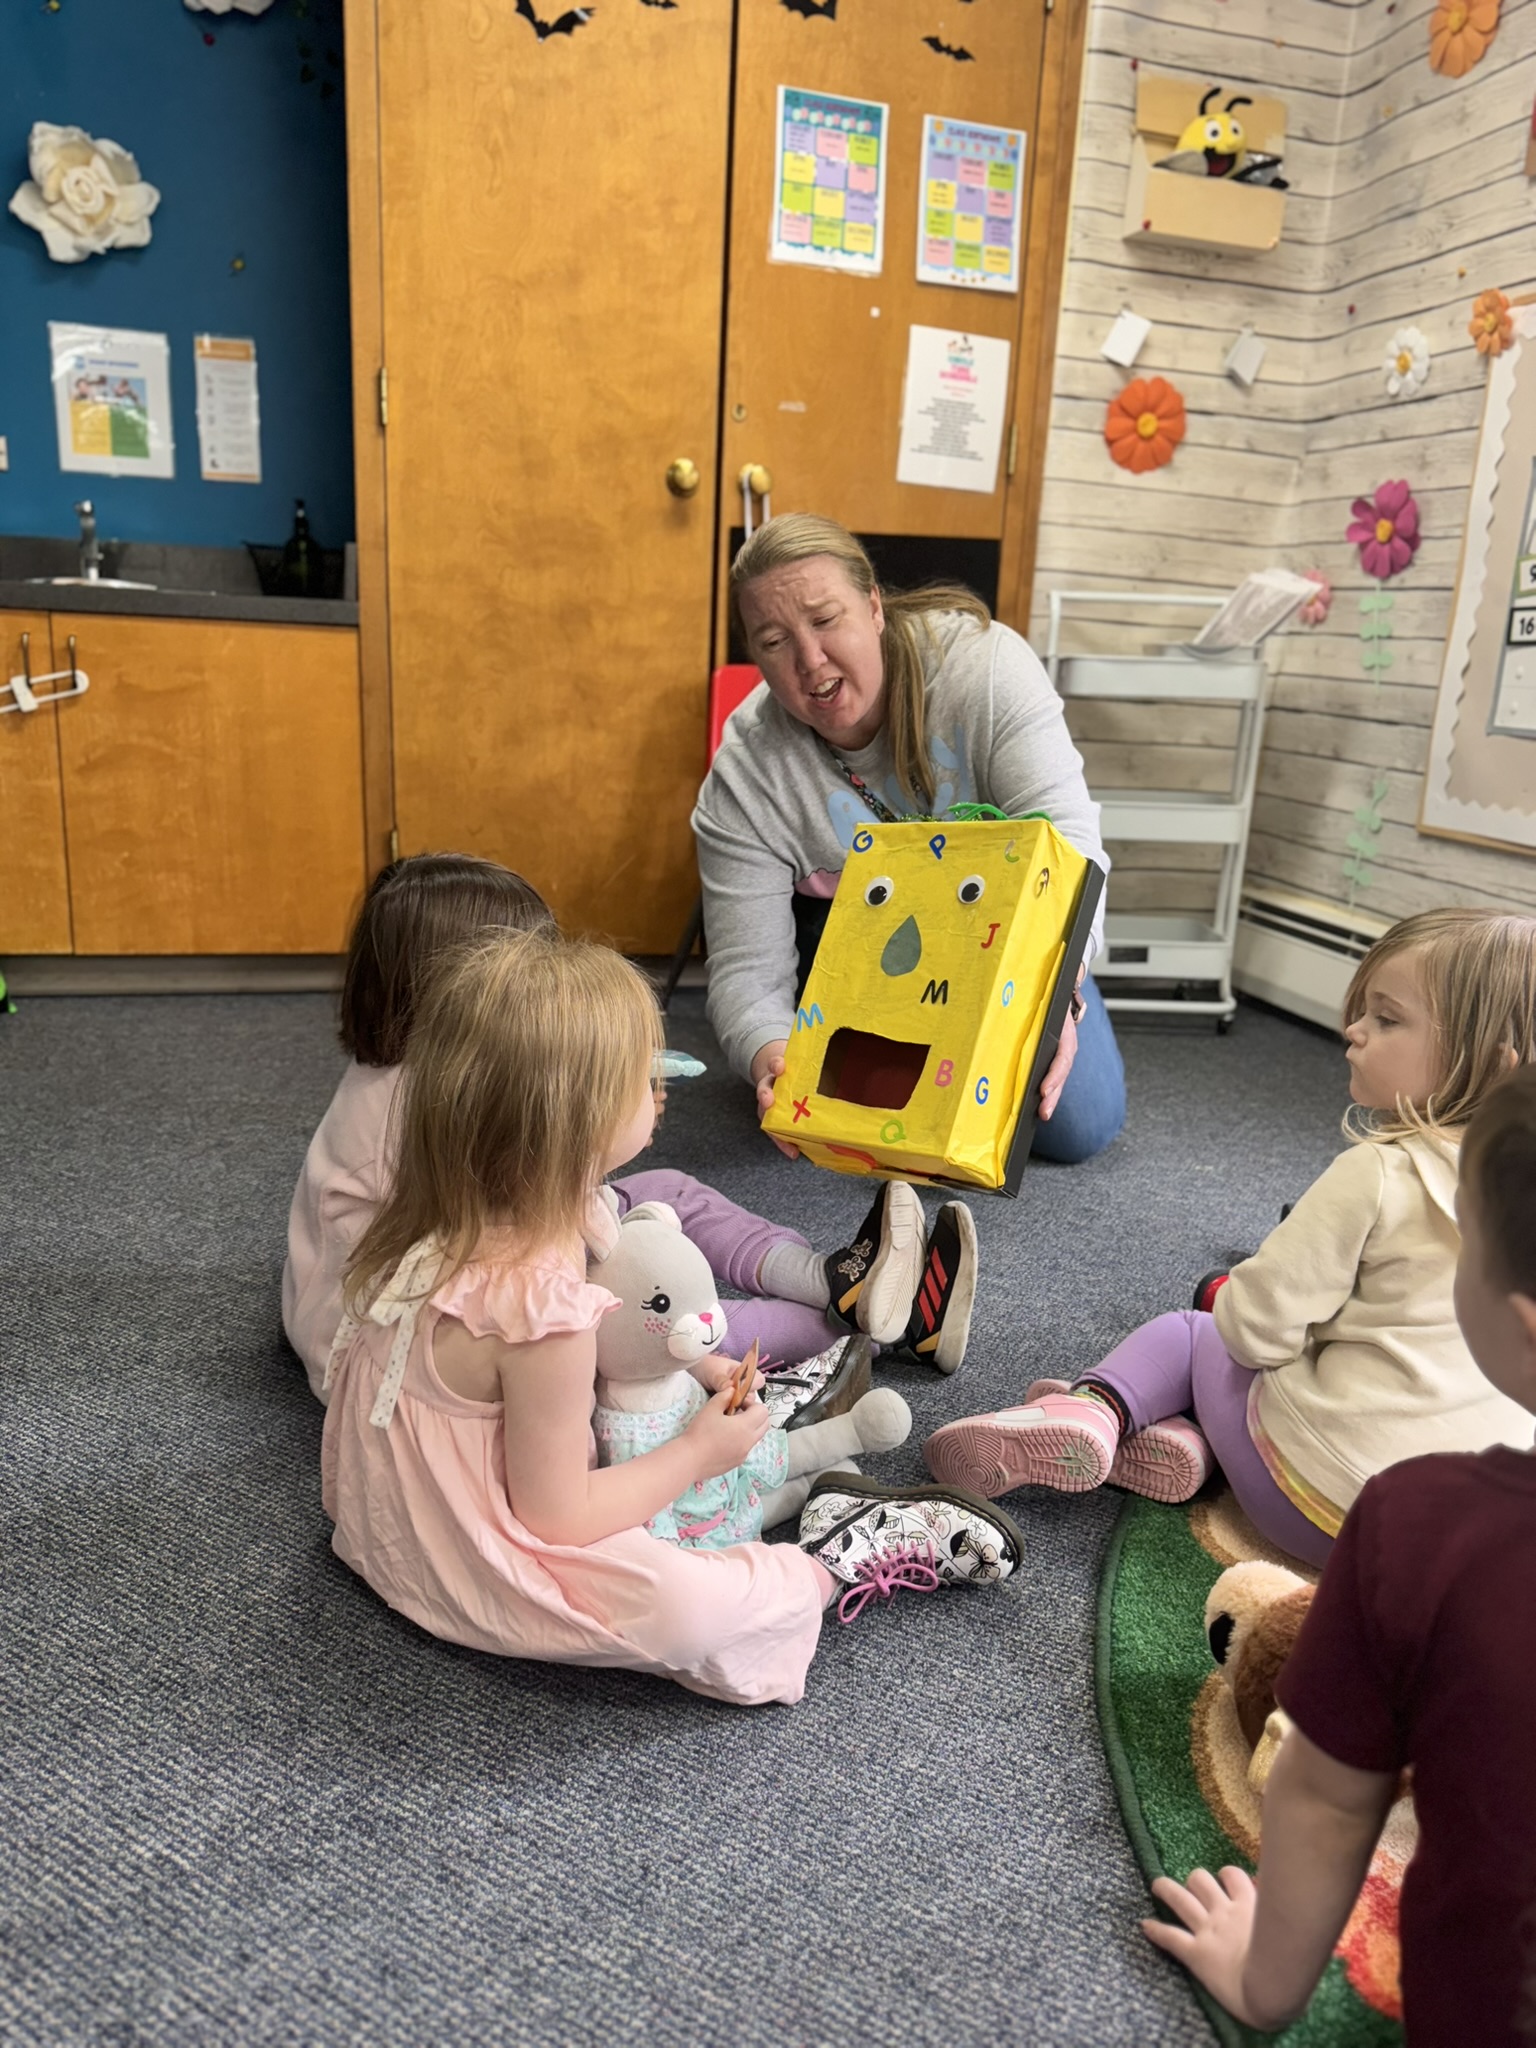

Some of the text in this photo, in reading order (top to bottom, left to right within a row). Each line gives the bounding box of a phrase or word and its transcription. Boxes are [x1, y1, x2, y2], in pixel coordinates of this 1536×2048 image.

[1520, 617, 1535, 636] 16
[852, 830, 873, 853] G
[929, 834, 947, 860] P
[980, 923, 1001, 949] J
[920, 979, 949, 1005] M
[796, 1003, 824, 1032] M
[934, 1059, 954, 1087] B
[975, 1076, 989, 1105] G
[793, 1096, 811, 1123] X
[880, 1119, 907, 1144] Q
